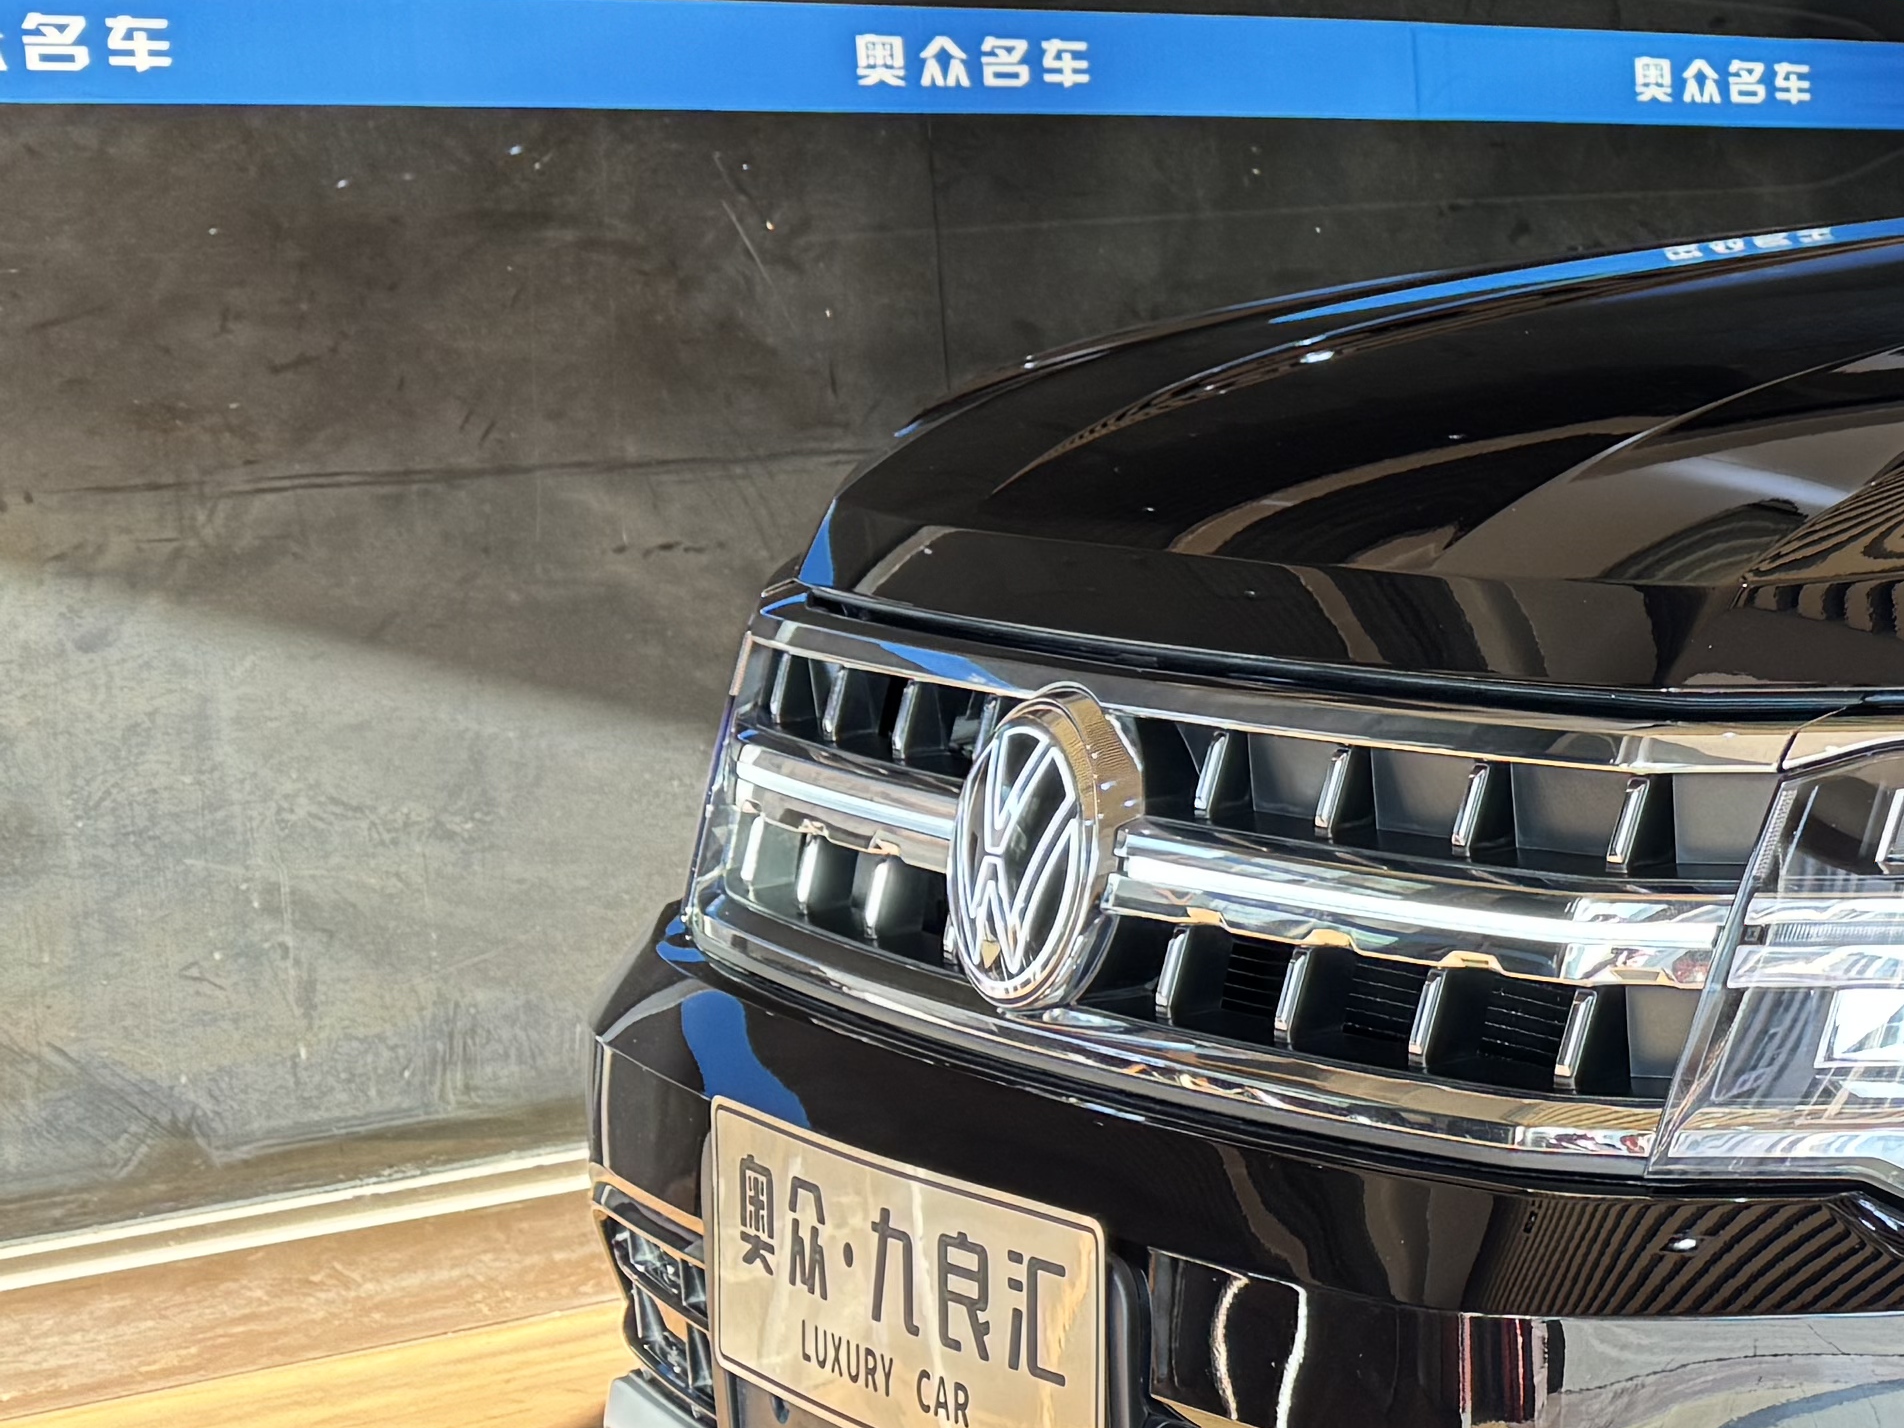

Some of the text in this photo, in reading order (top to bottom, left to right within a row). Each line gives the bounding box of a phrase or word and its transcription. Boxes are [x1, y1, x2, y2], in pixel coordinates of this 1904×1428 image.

[0, 12, 172, 73] 名车
[855, 33, 1090, 88] 奥众名车
[1634, 56, 1812, 105] 奥众名车
[739, 1154, 1067, 1387] 奥众·九良汇
[801, 1319, 971, 1428] LUXURY CAR
